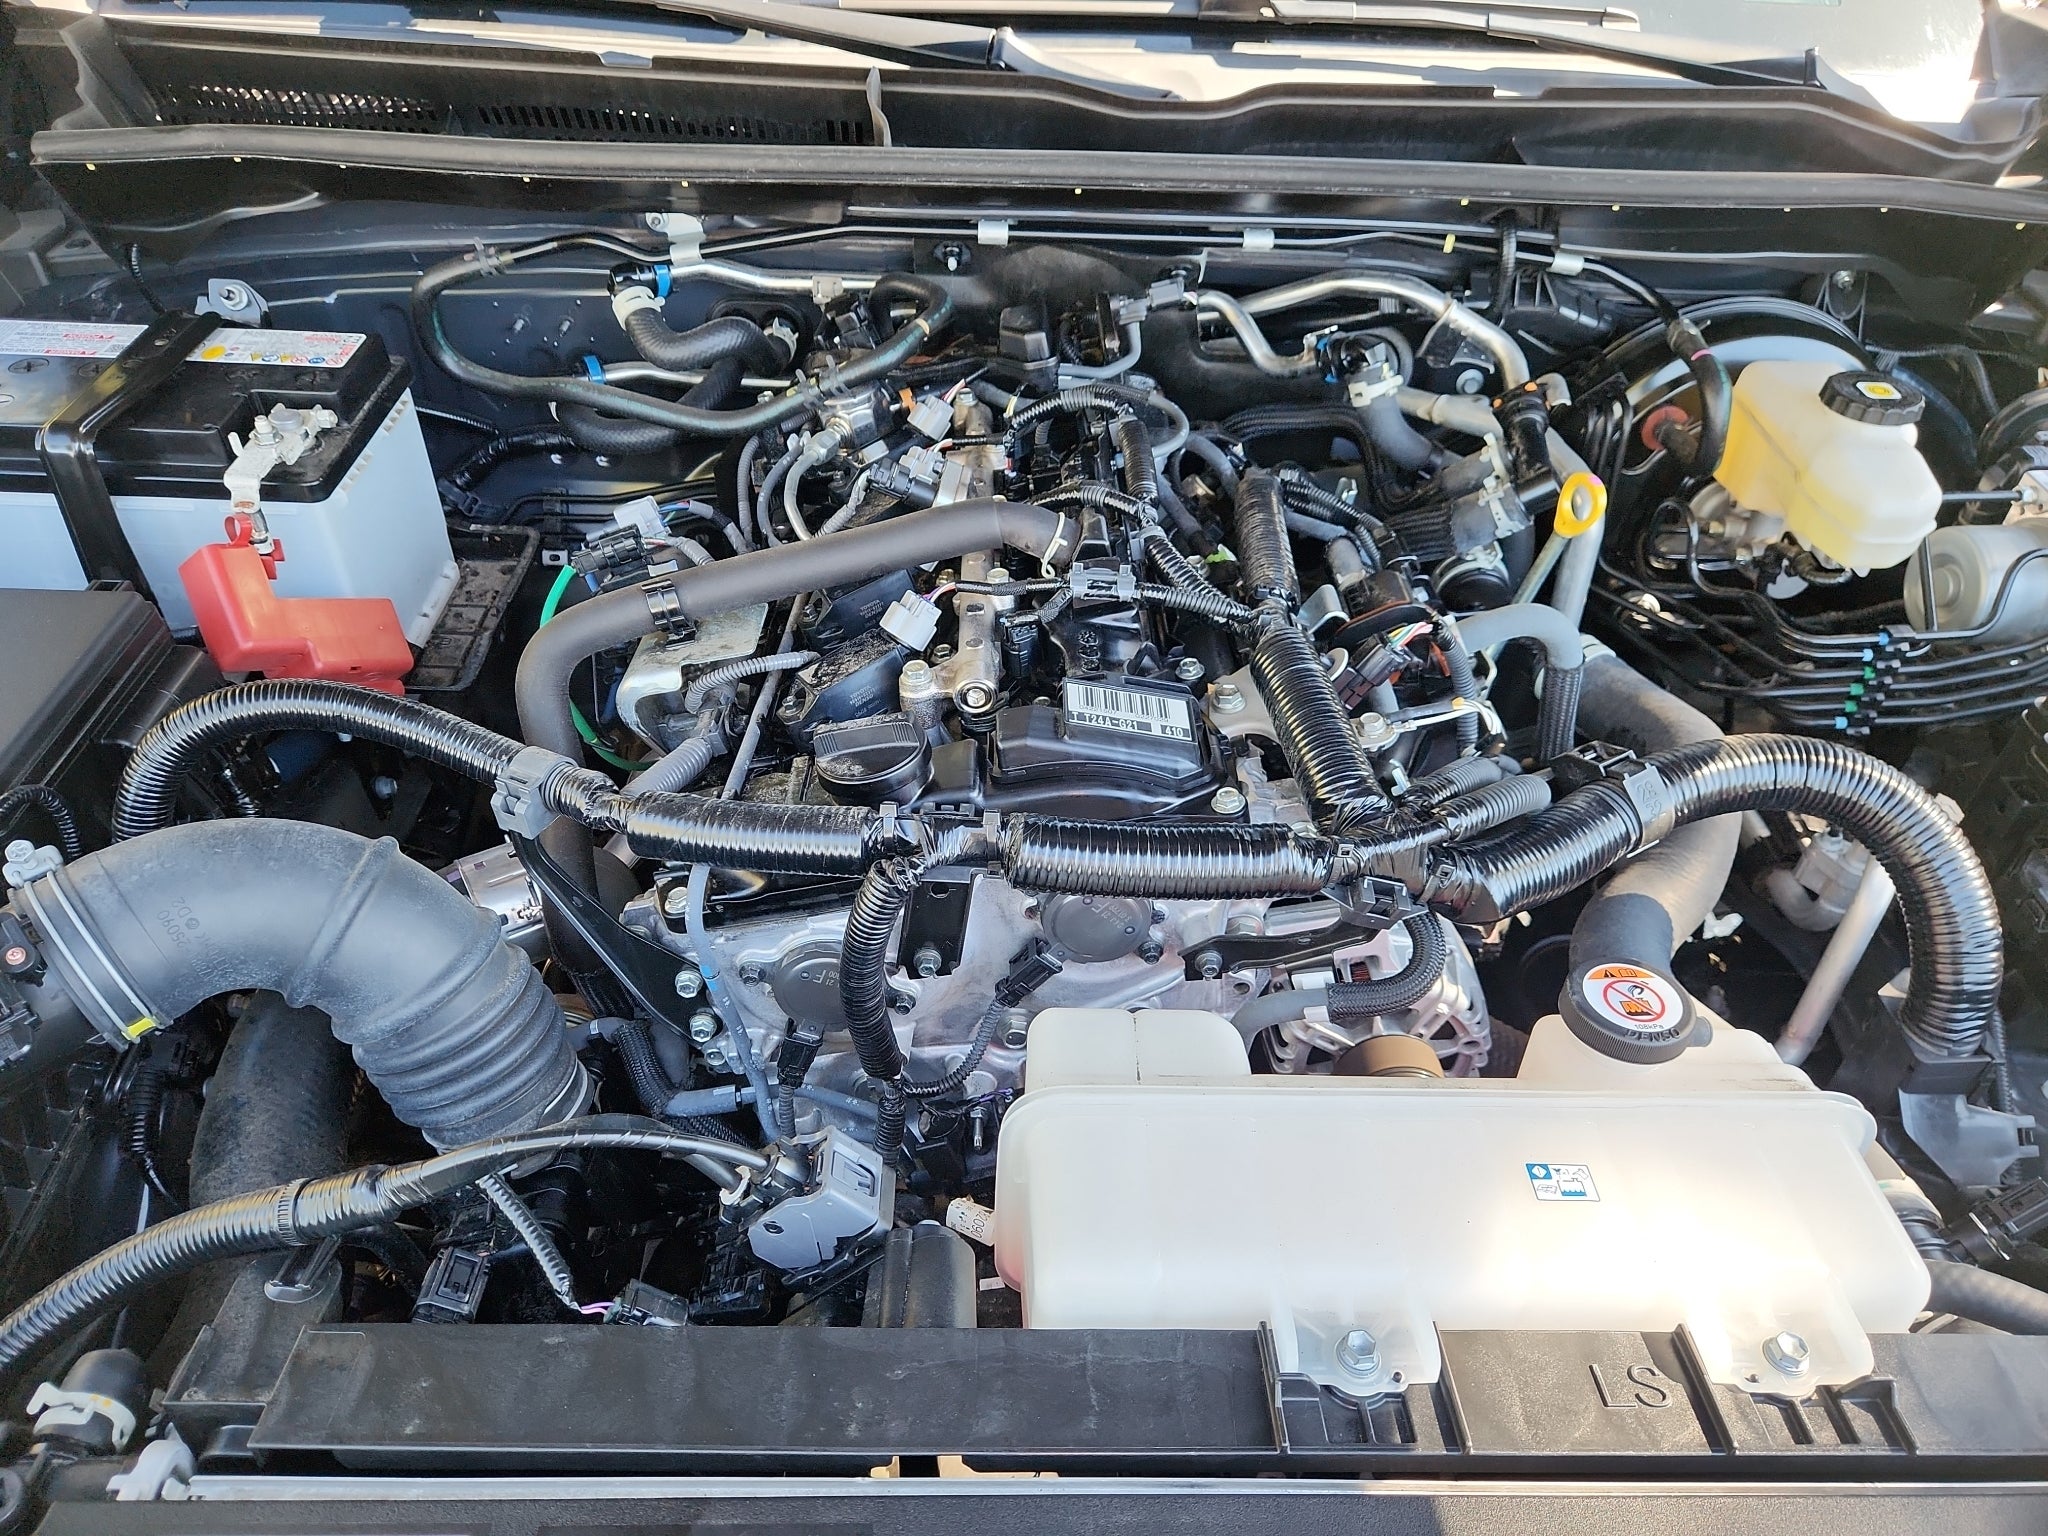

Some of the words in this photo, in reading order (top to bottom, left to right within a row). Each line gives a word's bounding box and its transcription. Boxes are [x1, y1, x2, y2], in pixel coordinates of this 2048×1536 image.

[850, 686, 872, 700] TOYOTA
[855, 694, 874, 707] DENSO
[1071, 711, 1079, 721] T
[1084, 712, 1138, 730] T24A-G21
[1165, 726, 1184, 738] 410
[1091, 901, 1111, 914] F
[812, 969, 827, 984] F
[1634, 1023, 1665, 1031] 108kPa
[1624, 1027, 1681, 1043] DENSO
[1588, 1363, 1673, 1409] LS
